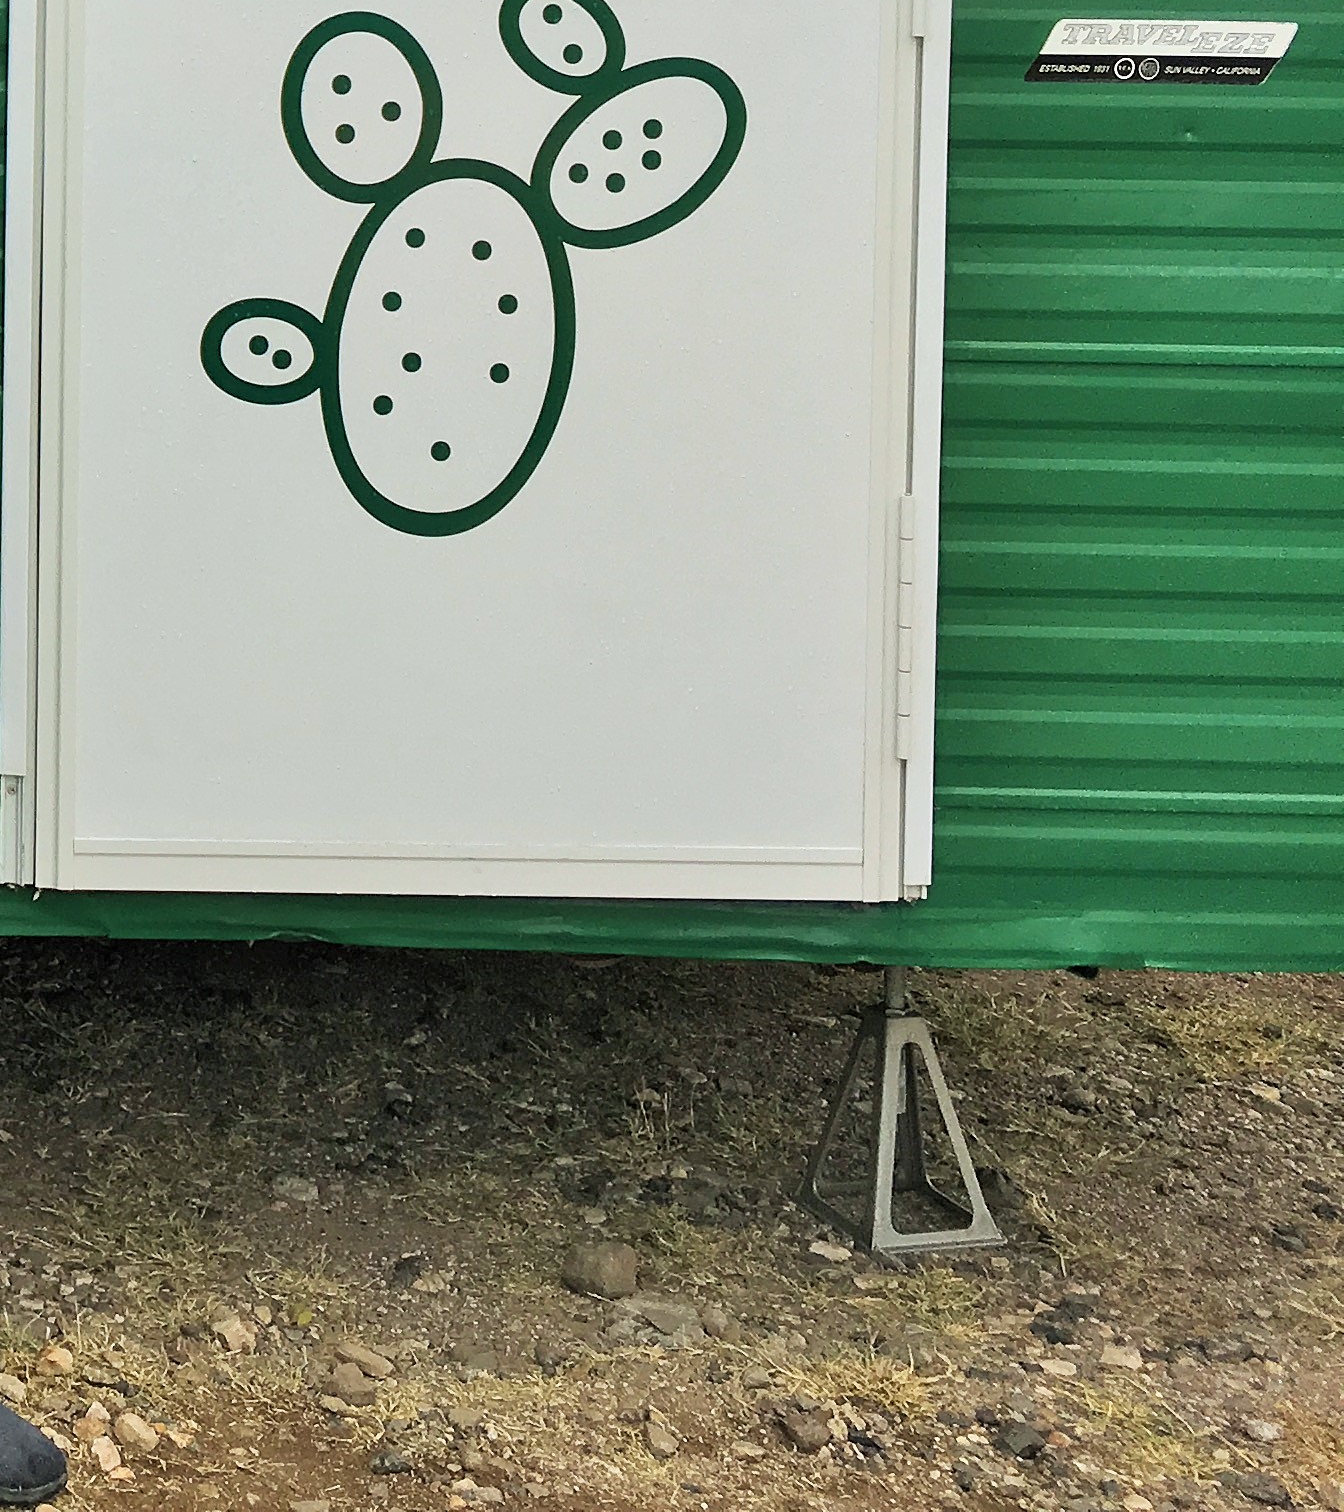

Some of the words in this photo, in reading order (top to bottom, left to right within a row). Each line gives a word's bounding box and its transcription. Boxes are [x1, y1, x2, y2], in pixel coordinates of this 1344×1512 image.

[1039, 64, 1089, 73] ESTABLISHED
[1164, 65, 1183, 74] SUN
[1183, 65, 1211, 74] VALLEY
[1216, 67, 1261, 75] CALIFORNIA
